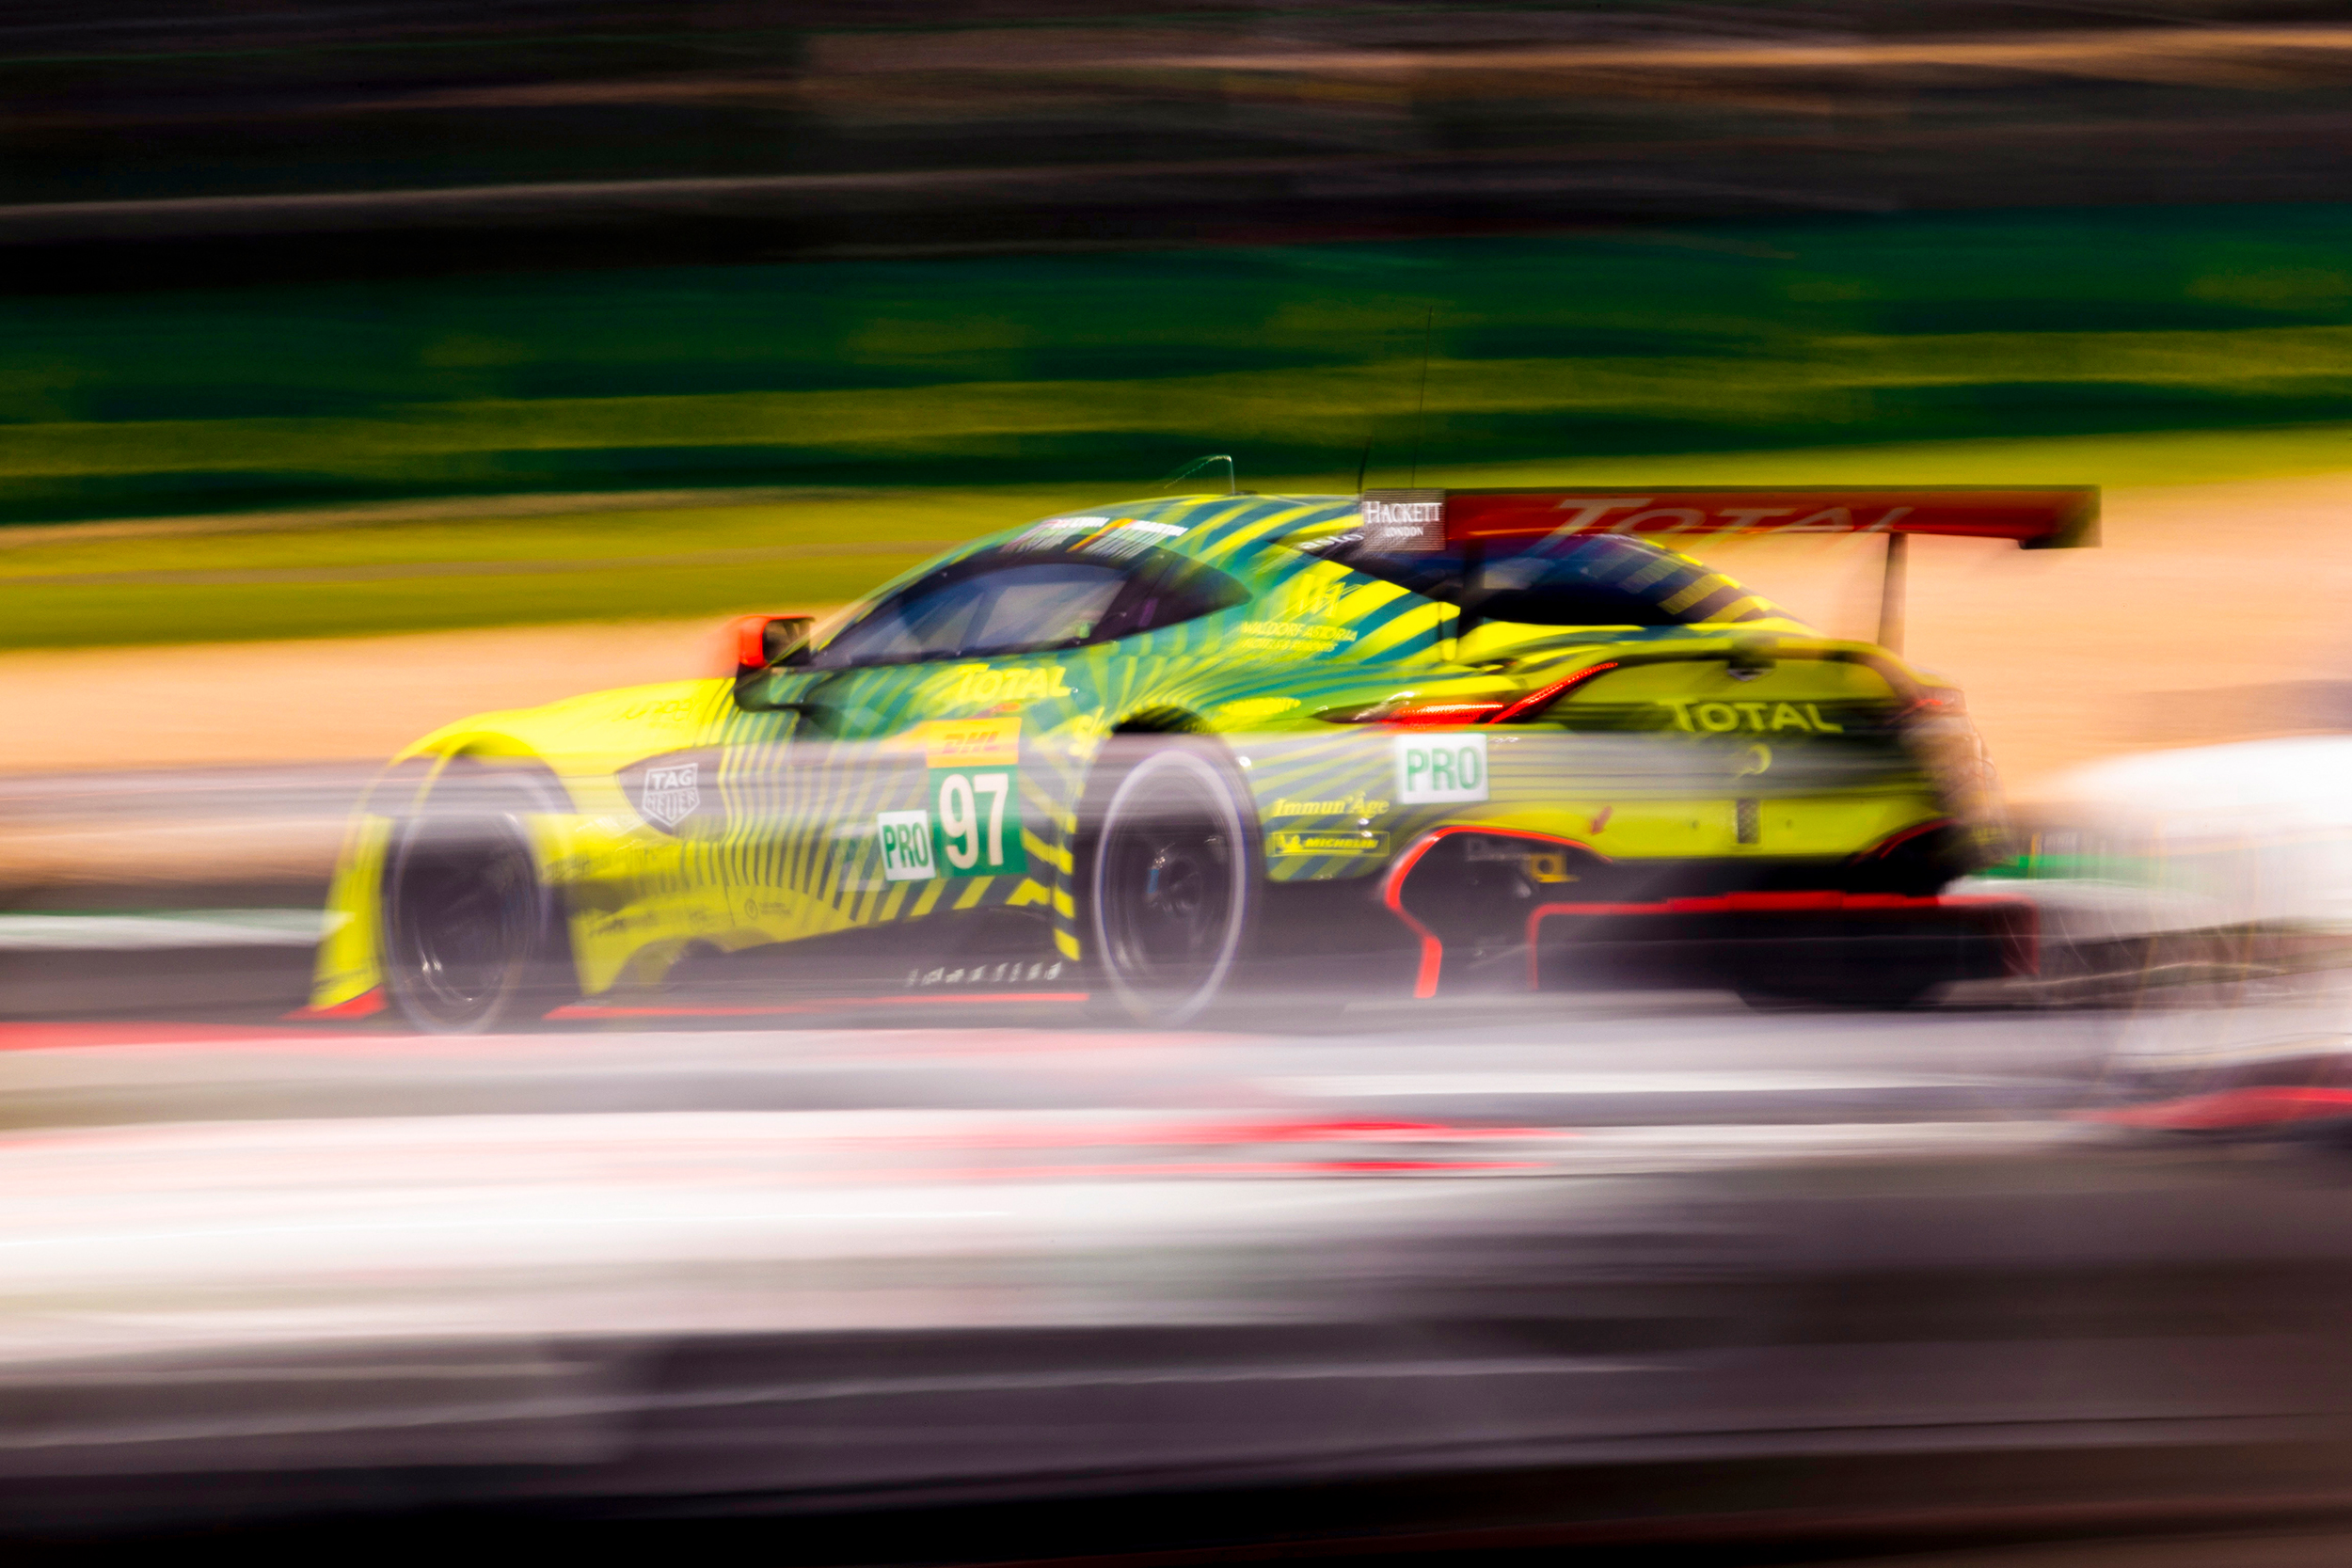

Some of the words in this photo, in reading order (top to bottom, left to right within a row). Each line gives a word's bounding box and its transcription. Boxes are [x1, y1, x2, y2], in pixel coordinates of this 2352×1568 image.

[1364, 500, 1443, 524] HACKETT
[1385, 526, 1424, 537] LONDON
[1303, 625, 1359, 641] ASTORIA
[956, 663, 1072, 703] TOTAL
[1659, 698, 1844, 733] TOTAL
[943, 731, 1001, 754] DHL
[652, 768, 693, 790] TAG
[1406, 746, 1483, 792] PRO
[645, 790, 696, 821] HEUER
[938, 772, 1009, 869] 97
[882, 821, 930, 869] PRO
[1305, 837, 1379, 849] MICHELIN
